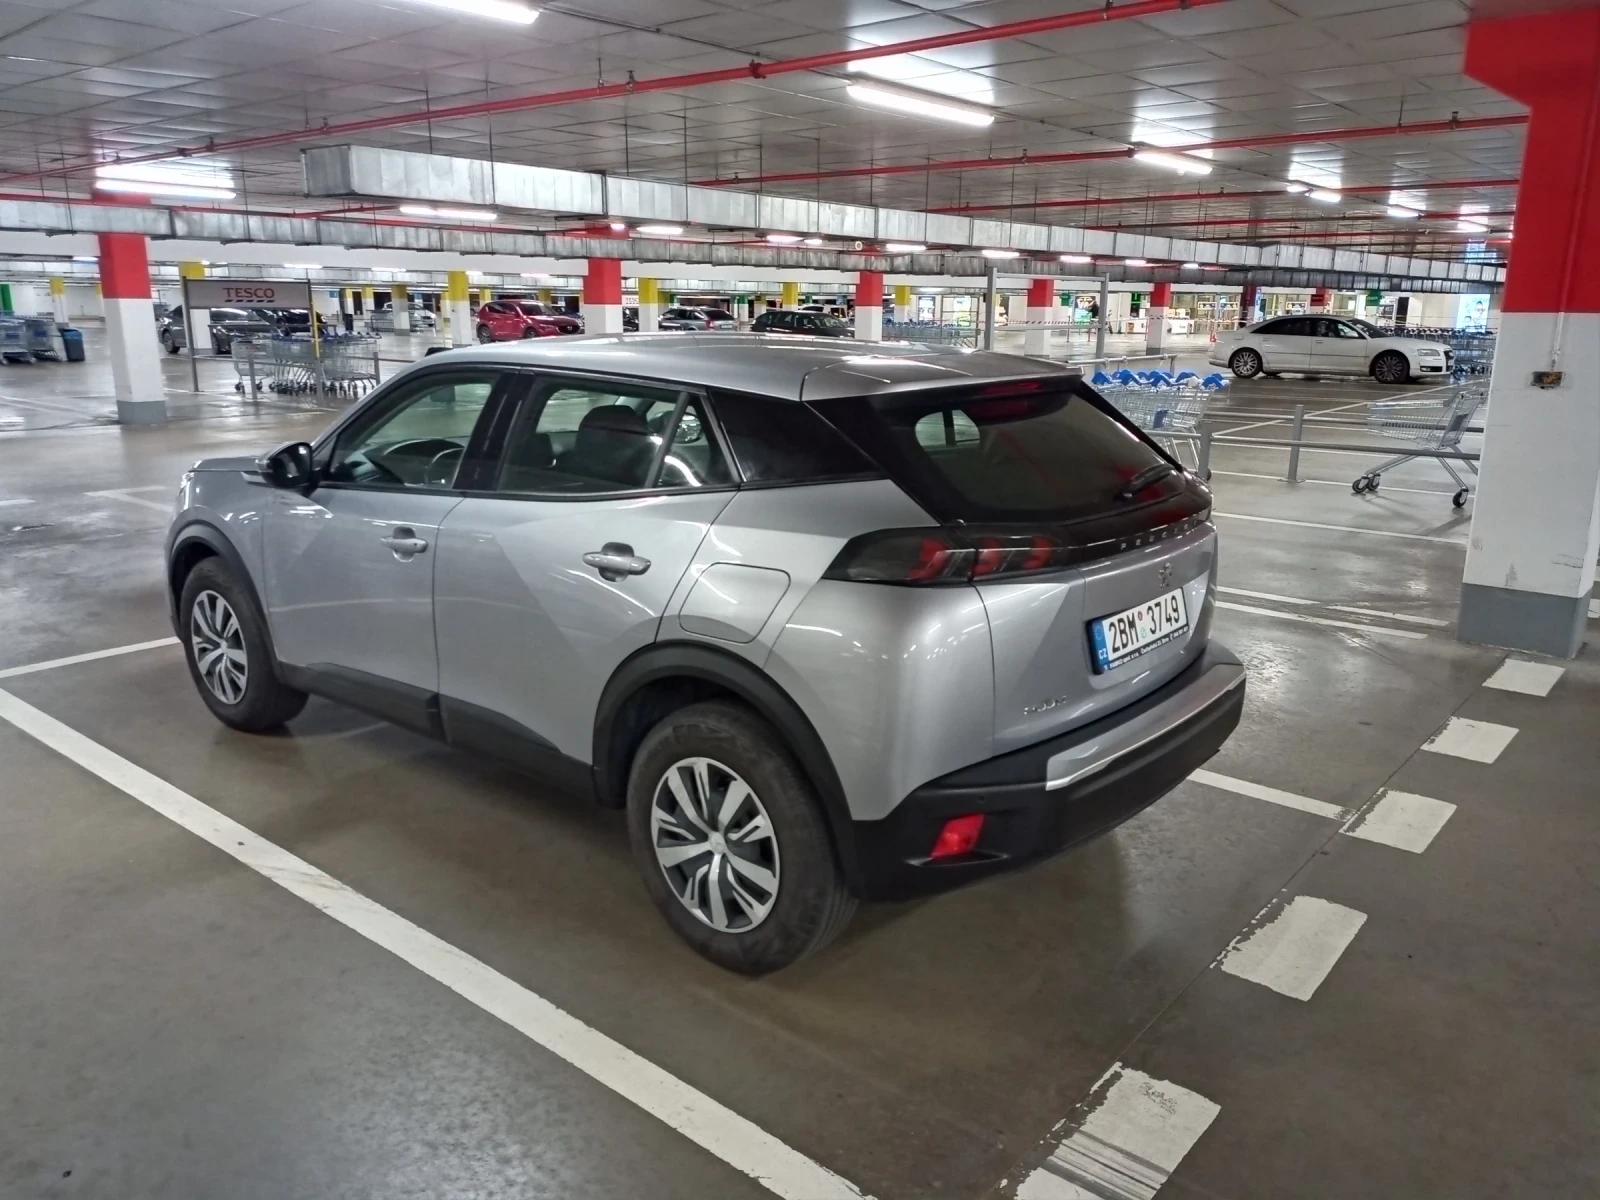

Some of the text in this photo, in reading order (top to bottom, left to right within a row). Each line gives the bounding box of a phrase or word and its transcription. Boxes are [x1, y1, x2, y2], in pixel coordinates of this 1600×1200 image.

[223, 287, 275, 299] TESCO
[1108, 594, 1180, 654] 2BM 3749
[1098, 648, 1108, 660] CZ
